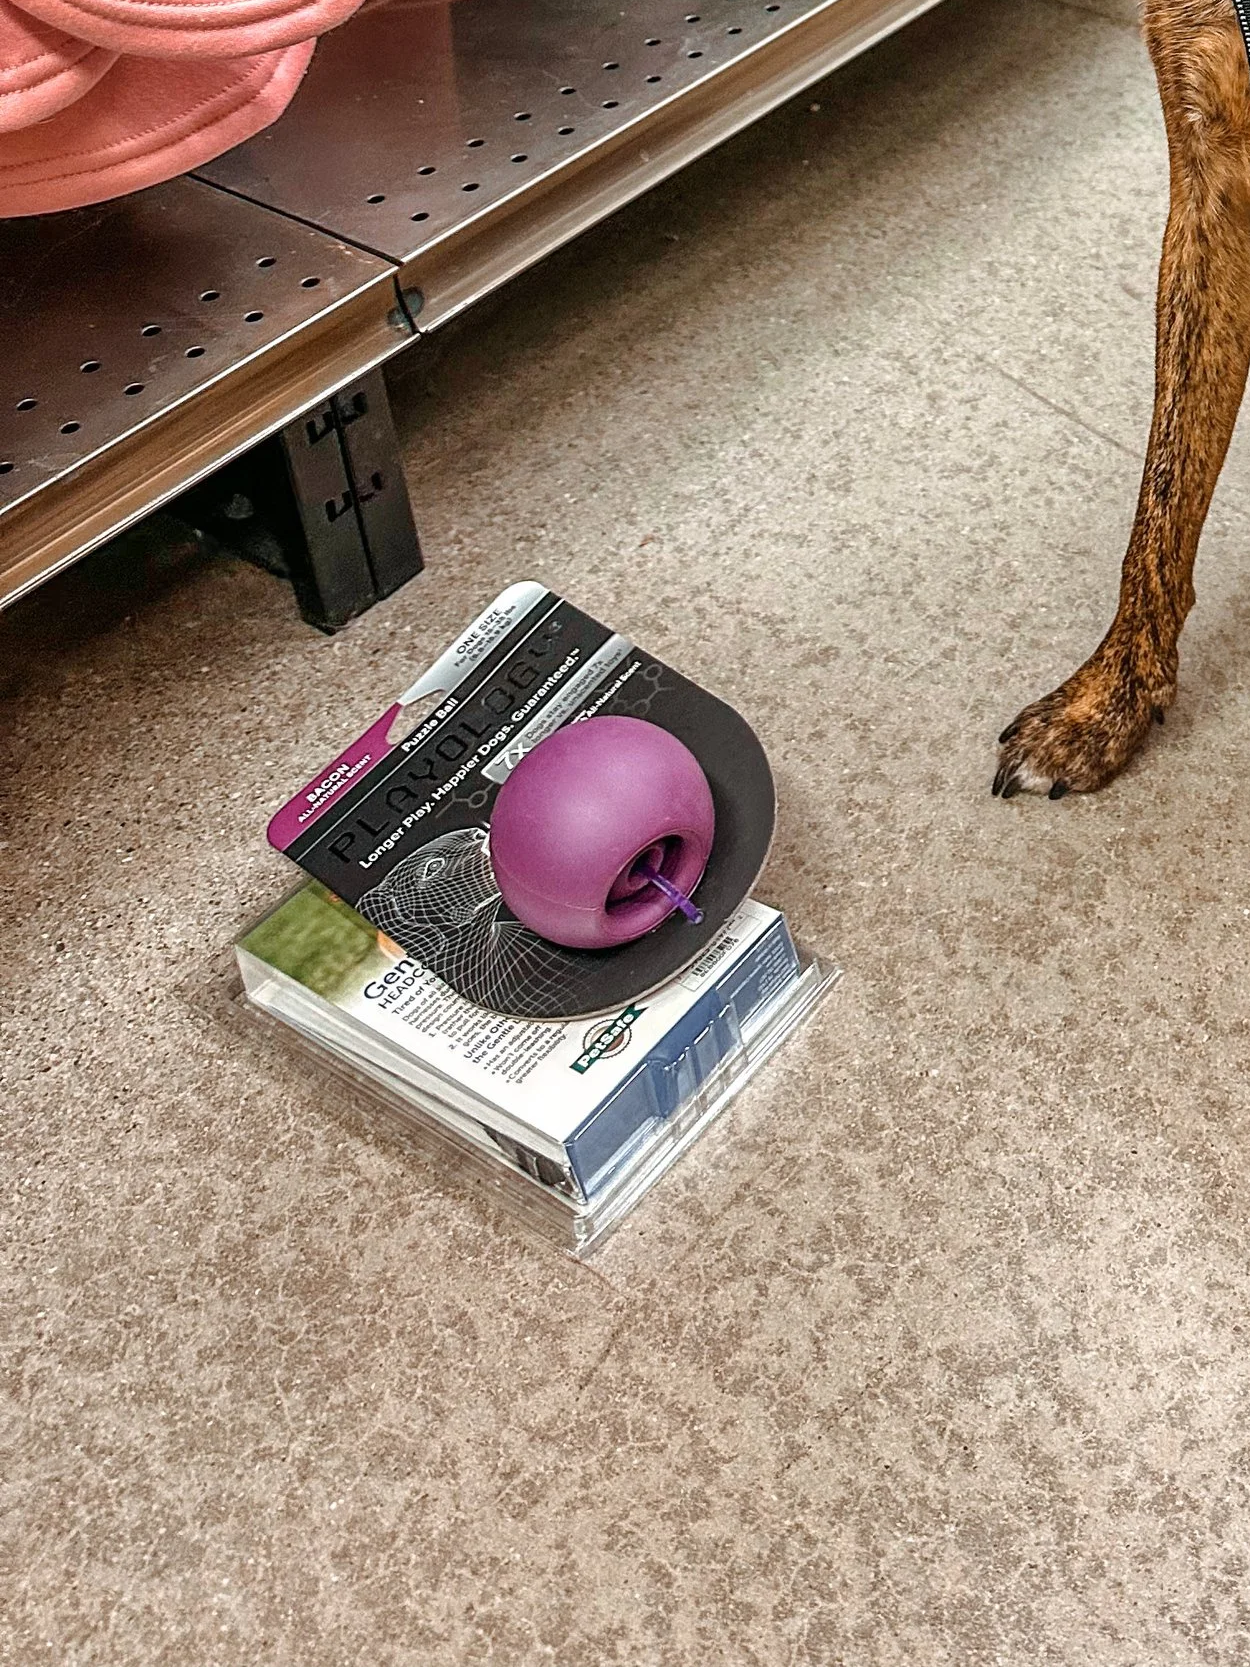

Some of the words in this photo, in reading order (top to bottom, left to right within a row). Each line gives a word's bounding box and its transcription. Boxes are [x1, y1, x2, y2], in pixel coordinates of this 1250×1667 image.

[457, 631, 480, 654] ONE
[479, 608, 503, 631] SIZE
[588, 682, 622, 717] All-Natural
[619, 661, 642, 682] Scent
[401, 717, 438, 753] Puzzle
[435, 697, 459, 722] Ball
[527, 722, 546, 740] Dogs
[547, 704, 563, 720] stay
[298, 776, 350, 823] ALL-NATURAL
[348, 755, 372, 778] SCENT
[306, 763, 350, 803] BACON
[359, 827, 405, 869] Longer
[403, 801, 435, 828] Play.
[431, 756, 478, 801] Happier
[478, 725, 514, 756] Dogs.
[391, 995, 415, 1014] Tired
[415, 986, 424, 995] of
[402, 1006, 421, 1021] Dogs
[420, 997, 428, 1006] of
[435, 1005, 463, 1030] Pressure
[463, 1034, 491, 1058] Unlike
[472, 1050, 488, 1063] the
[486, 1025, 514, 1049] Gentle
[578, 1014, 634, 1067] PetSafe
